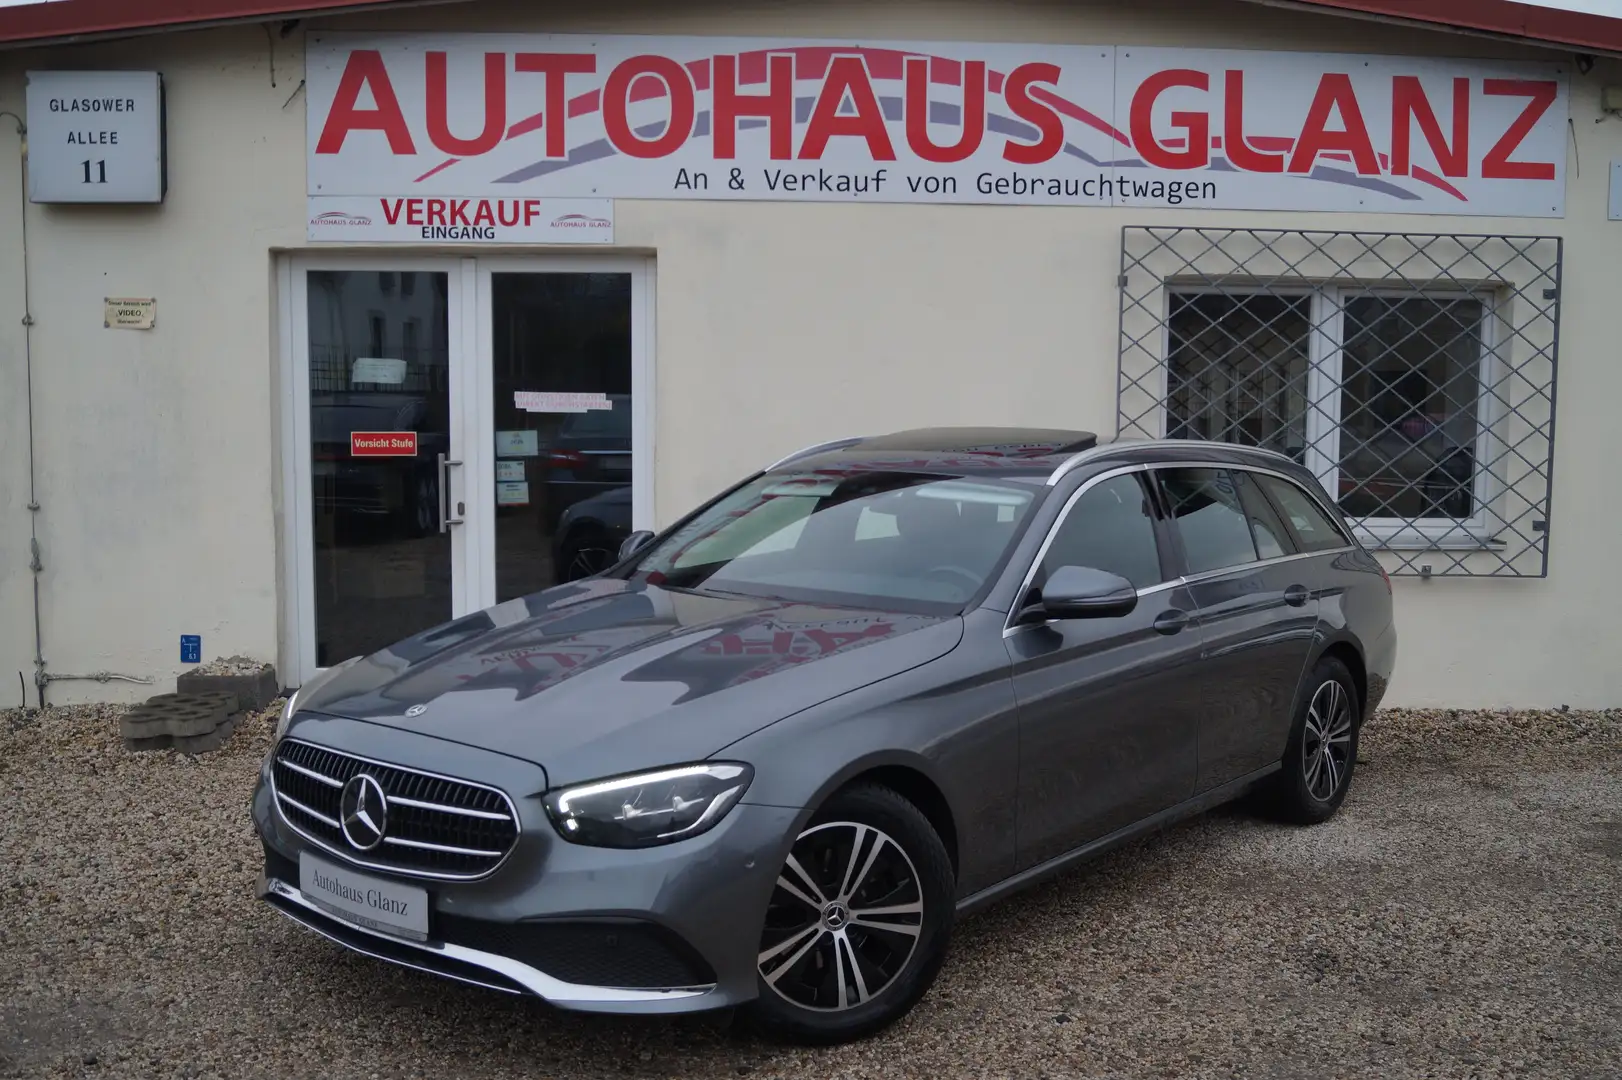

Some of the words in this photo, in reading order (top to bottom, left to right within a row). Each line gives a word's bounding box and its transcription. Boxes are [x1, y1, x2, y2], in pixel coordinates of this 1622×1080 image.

[49, 98, 135, 112] GLASOWER
[315, 49, 1064, 165] AUTOHAUS
[1129, 68, 1557, 180] GLANZ
[67, 131, 118, 144] ALLEE
[80, 158, 108, 184] 11
[674, 167, 708, 190] An
[728, 167, 745, 191] &
[764, 168, 887, 193] Verkauf
[906, 175, 957, 194] von
[976, 171, 1216, 205] Gebrauchtwagen
[379, 197, 541, 227] VERKAUF
[421, 226, 495, 239] EINGANG
[354, 438, 389, 448] Vorsicht
[391, 438, 413, 448] Stufe
[312, 869, 363, 904] Autohaus
[367, 889, 408, 916] Glanz
